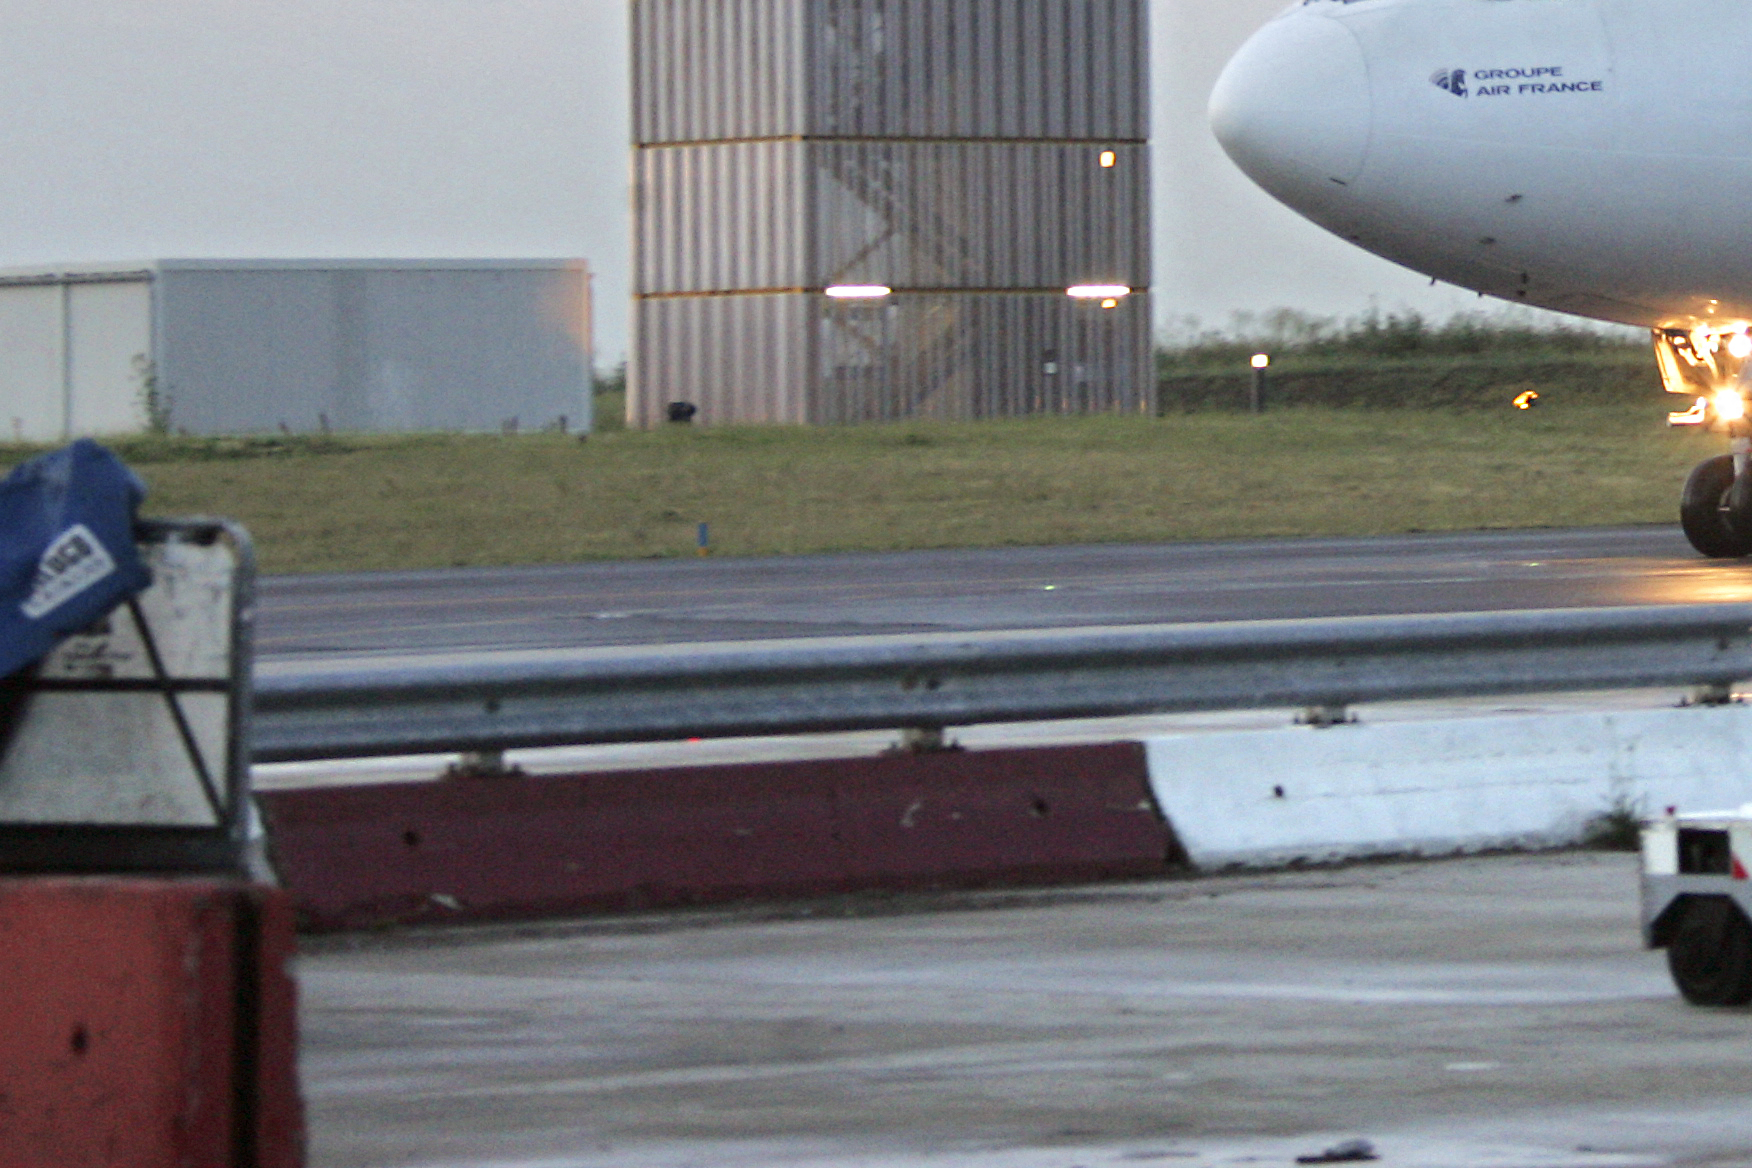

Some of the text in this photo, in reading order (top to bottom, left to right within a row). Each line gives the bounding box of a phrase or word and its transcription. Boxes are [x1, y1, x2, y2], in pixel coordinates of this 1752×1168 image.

[1474, 66, 1563, 80] GROUPE
[1476, 81, 1603, 97] AIR FRANCE
